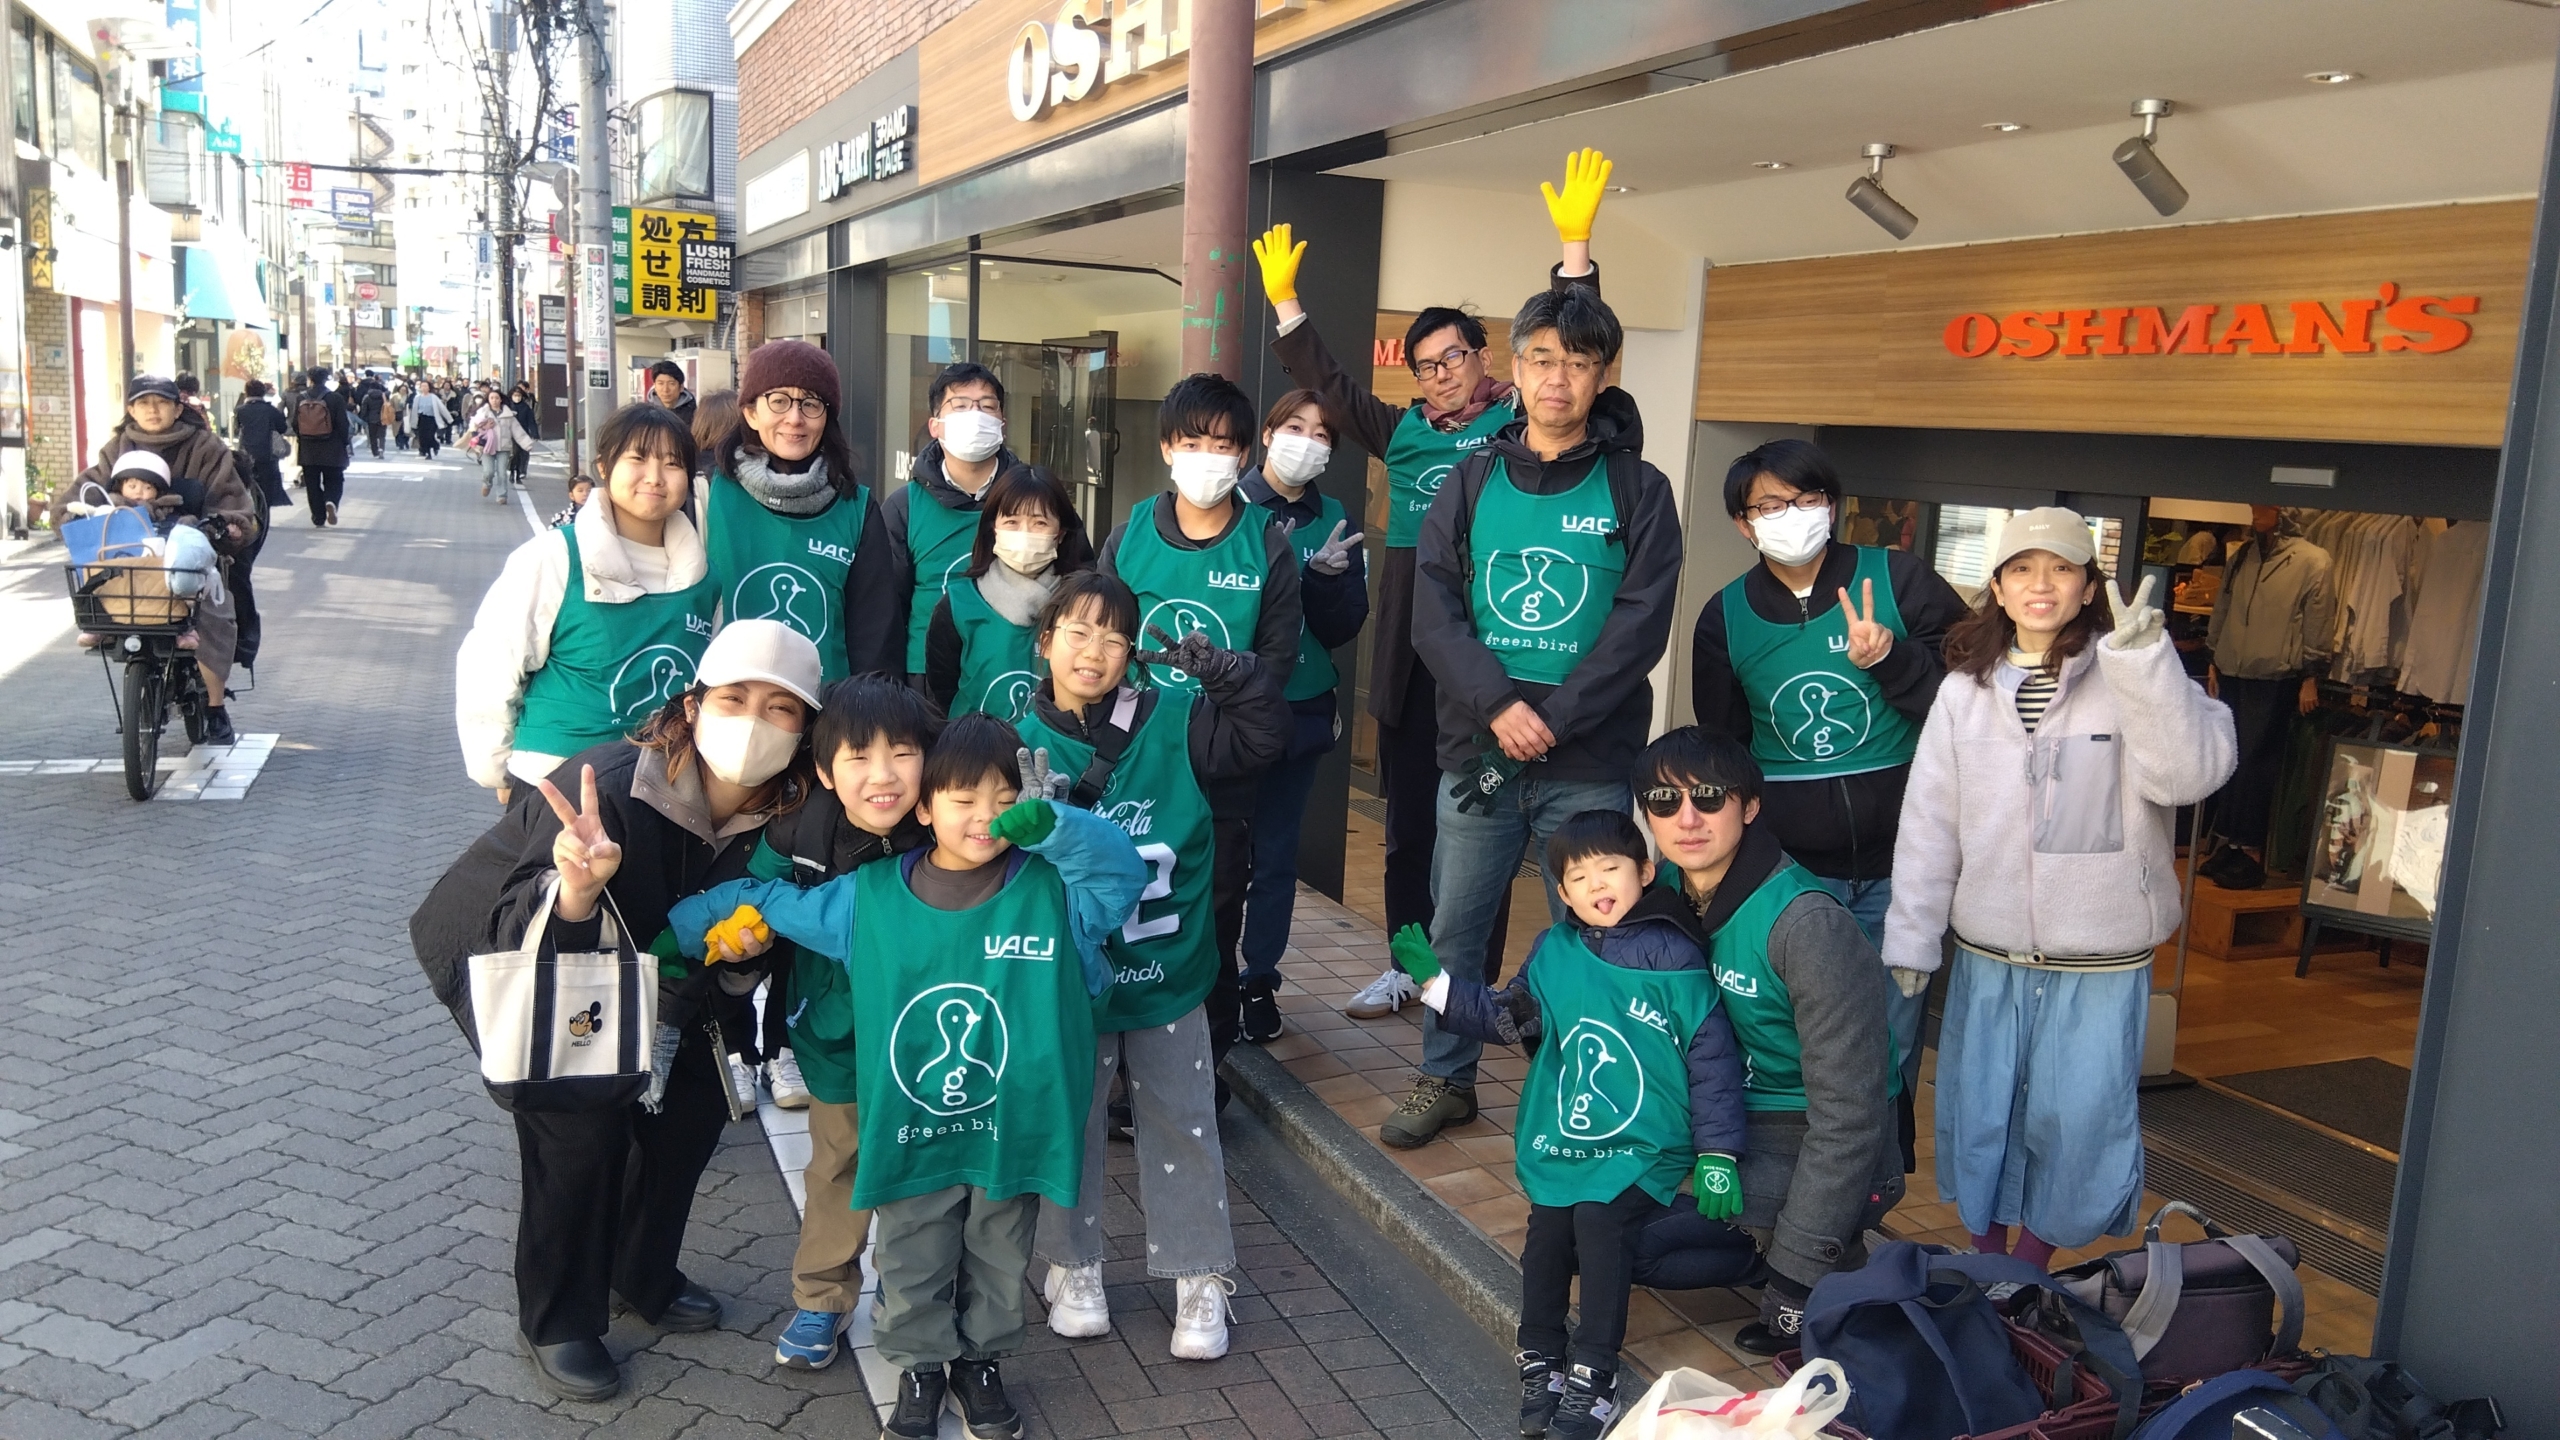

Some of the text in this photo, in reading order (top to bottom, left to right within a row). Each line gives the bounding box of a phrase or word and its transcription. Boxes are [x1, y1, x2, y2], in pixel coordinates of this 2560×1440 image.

[875, 105, 908, 149] GRAND
[819, 130, 869, 202] ABC-MART
[875, 140, 904, 180] STAGE
[611, 217, 629, 303] 稲垣薬局
[686, 244, 730, 259] LUSH
[686, 257, 730, 270] FRESH
[686, 269, 730, 278] HANDMADE
[687, 276, 730, 286] COSMETICS
[594, 268, 605, 336] ゆいメンタル
[641, 283, 706, 313] 調剤
[1943, 282, 2480, 358] OSHMAN'S
[1208, 570, 1260, 590] UACJ
[1485, 632, 1578, 653] green bird
[984, 935, 1055, 961] UACJ
[1713, 963, 1758, 997] UACJ
[897, 1122, 965, 1144] green
[1532, 1135, 1587, 1159] green
